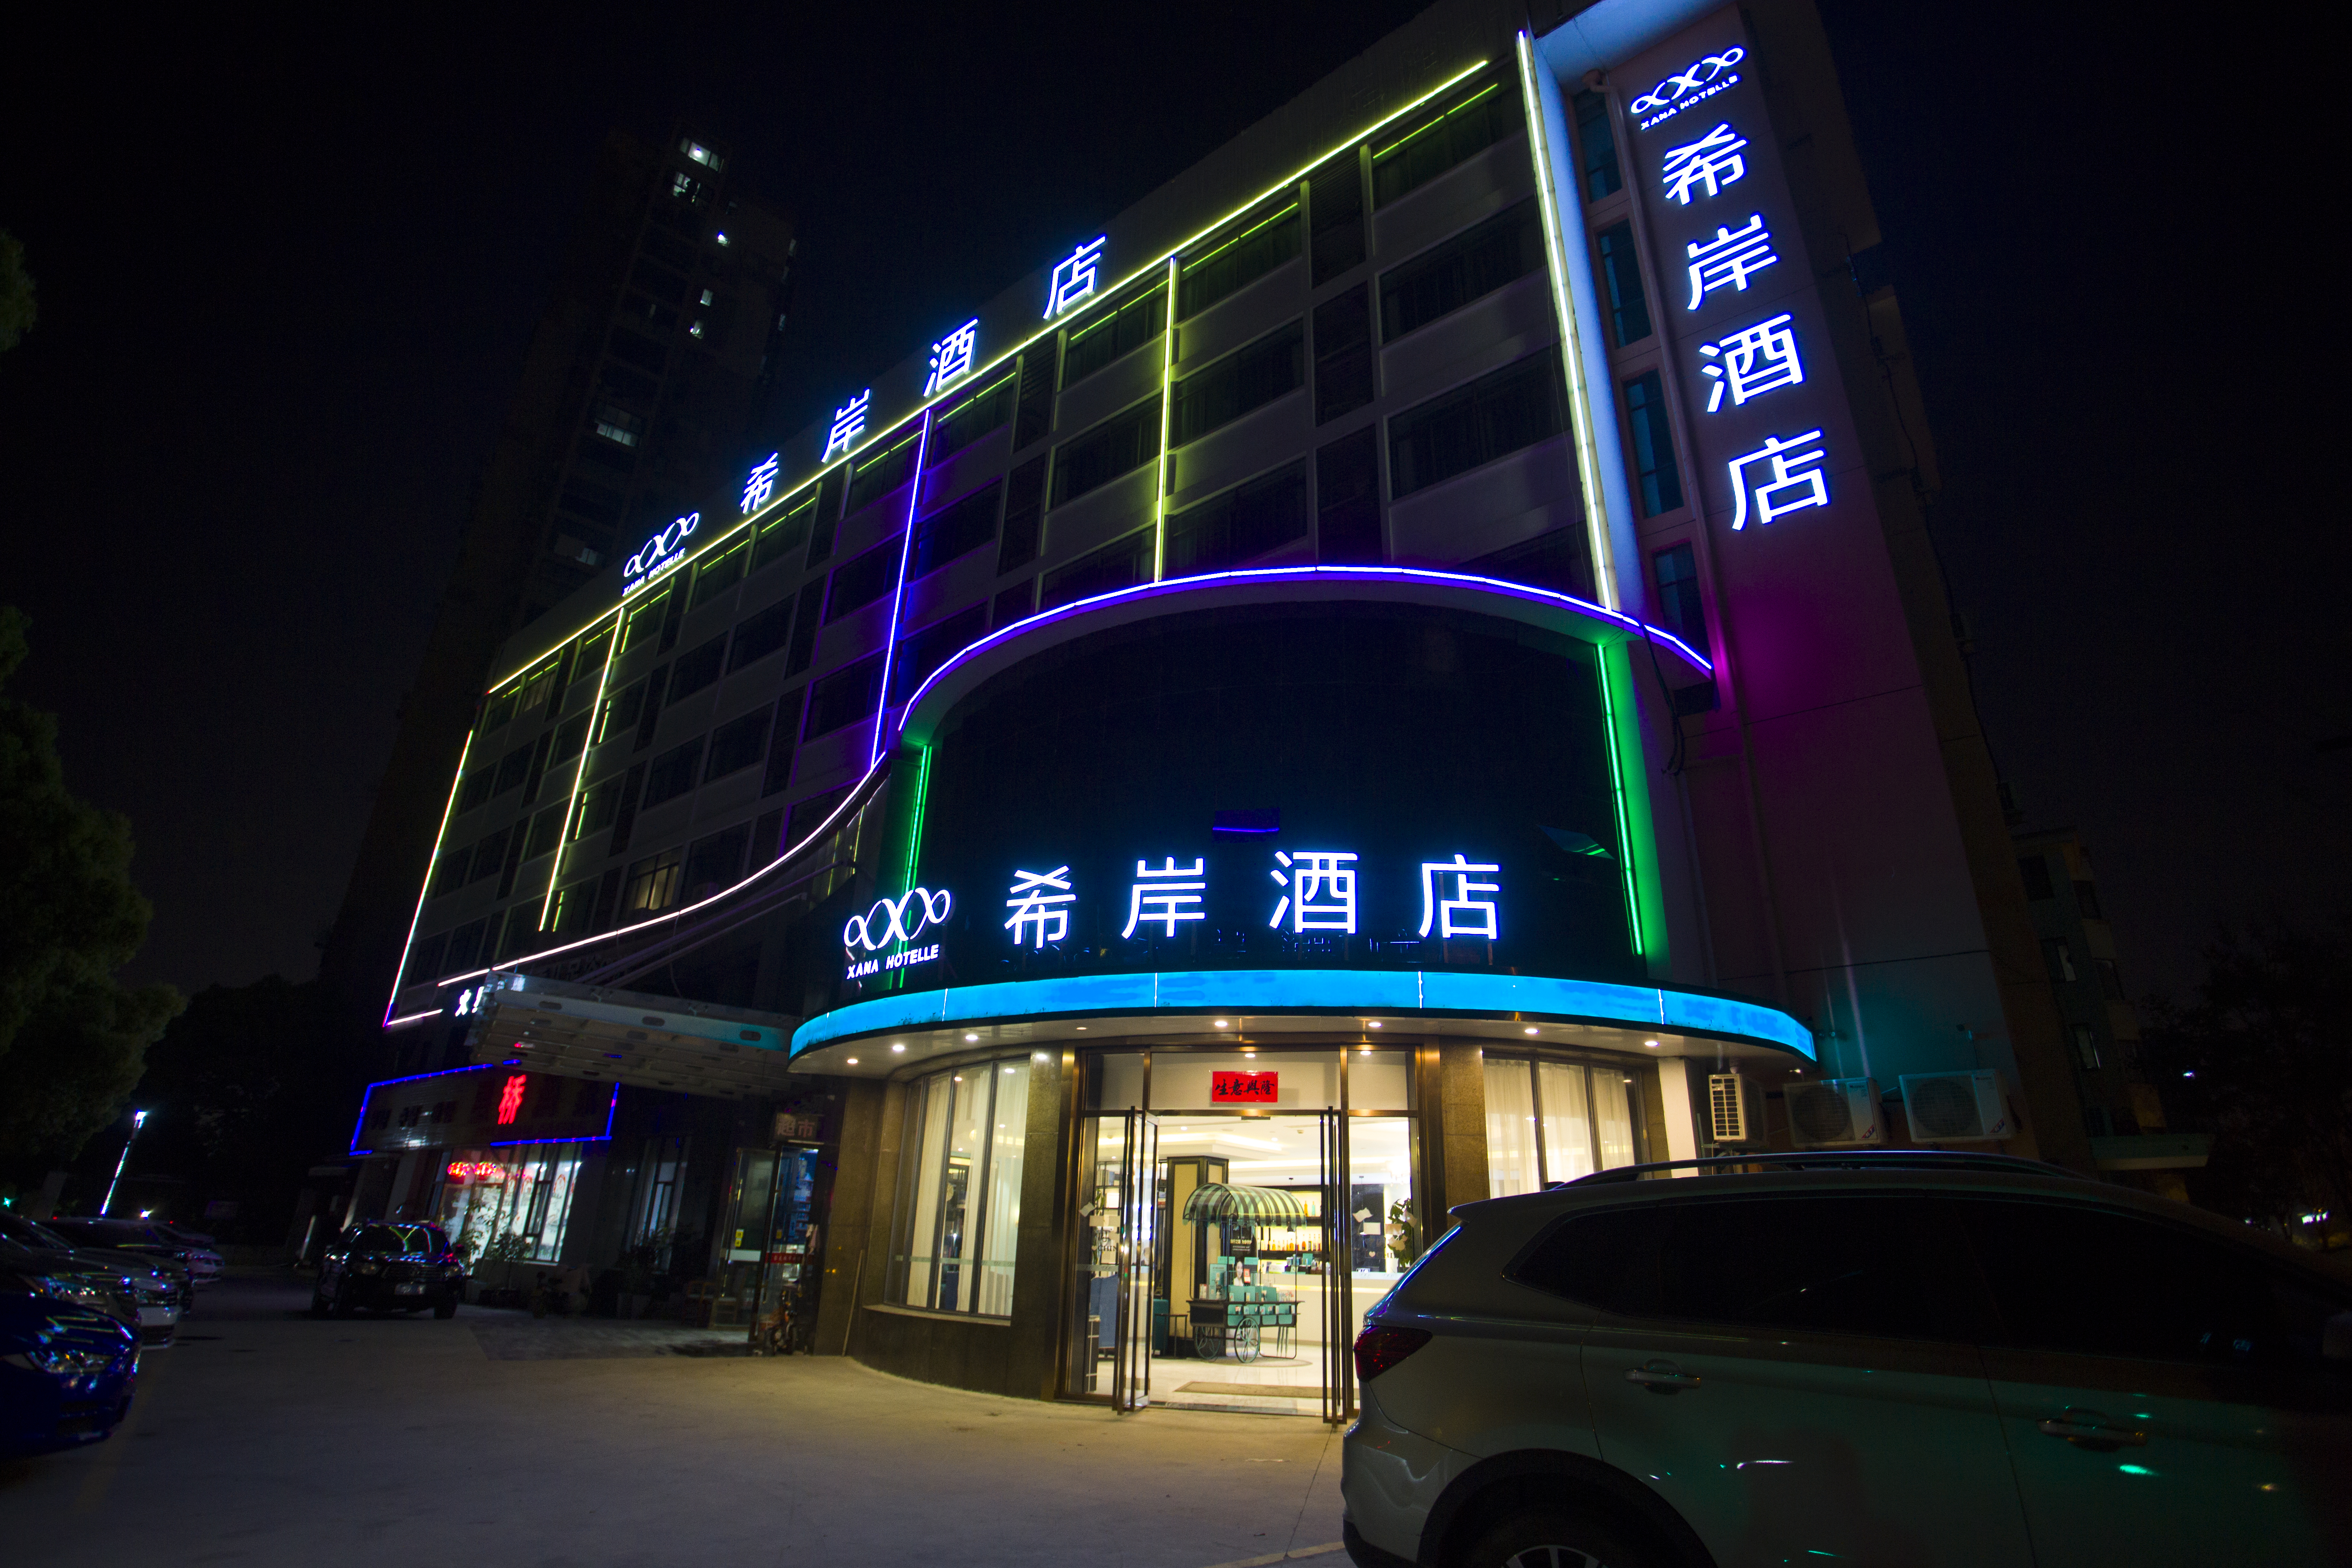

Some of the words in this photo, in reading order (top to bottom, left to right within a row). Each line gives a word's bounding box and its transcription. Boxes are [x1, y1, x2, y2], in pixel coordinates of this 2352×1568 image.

[1640, 107, 1677, 130] XANA
[1679, 75, 1738, 110] HOTELLE
[1662, 123, 1829, 531] 希岸酒店
[739, 235, 1106, 514] 希岸酒店
[1003, 850, 1500, 949] 希岸酒店
[846, 959, 879, 980] XANA
[885, 944, 939, 970] HOTELLE
[777, 1118, 815, 1138] 超市
